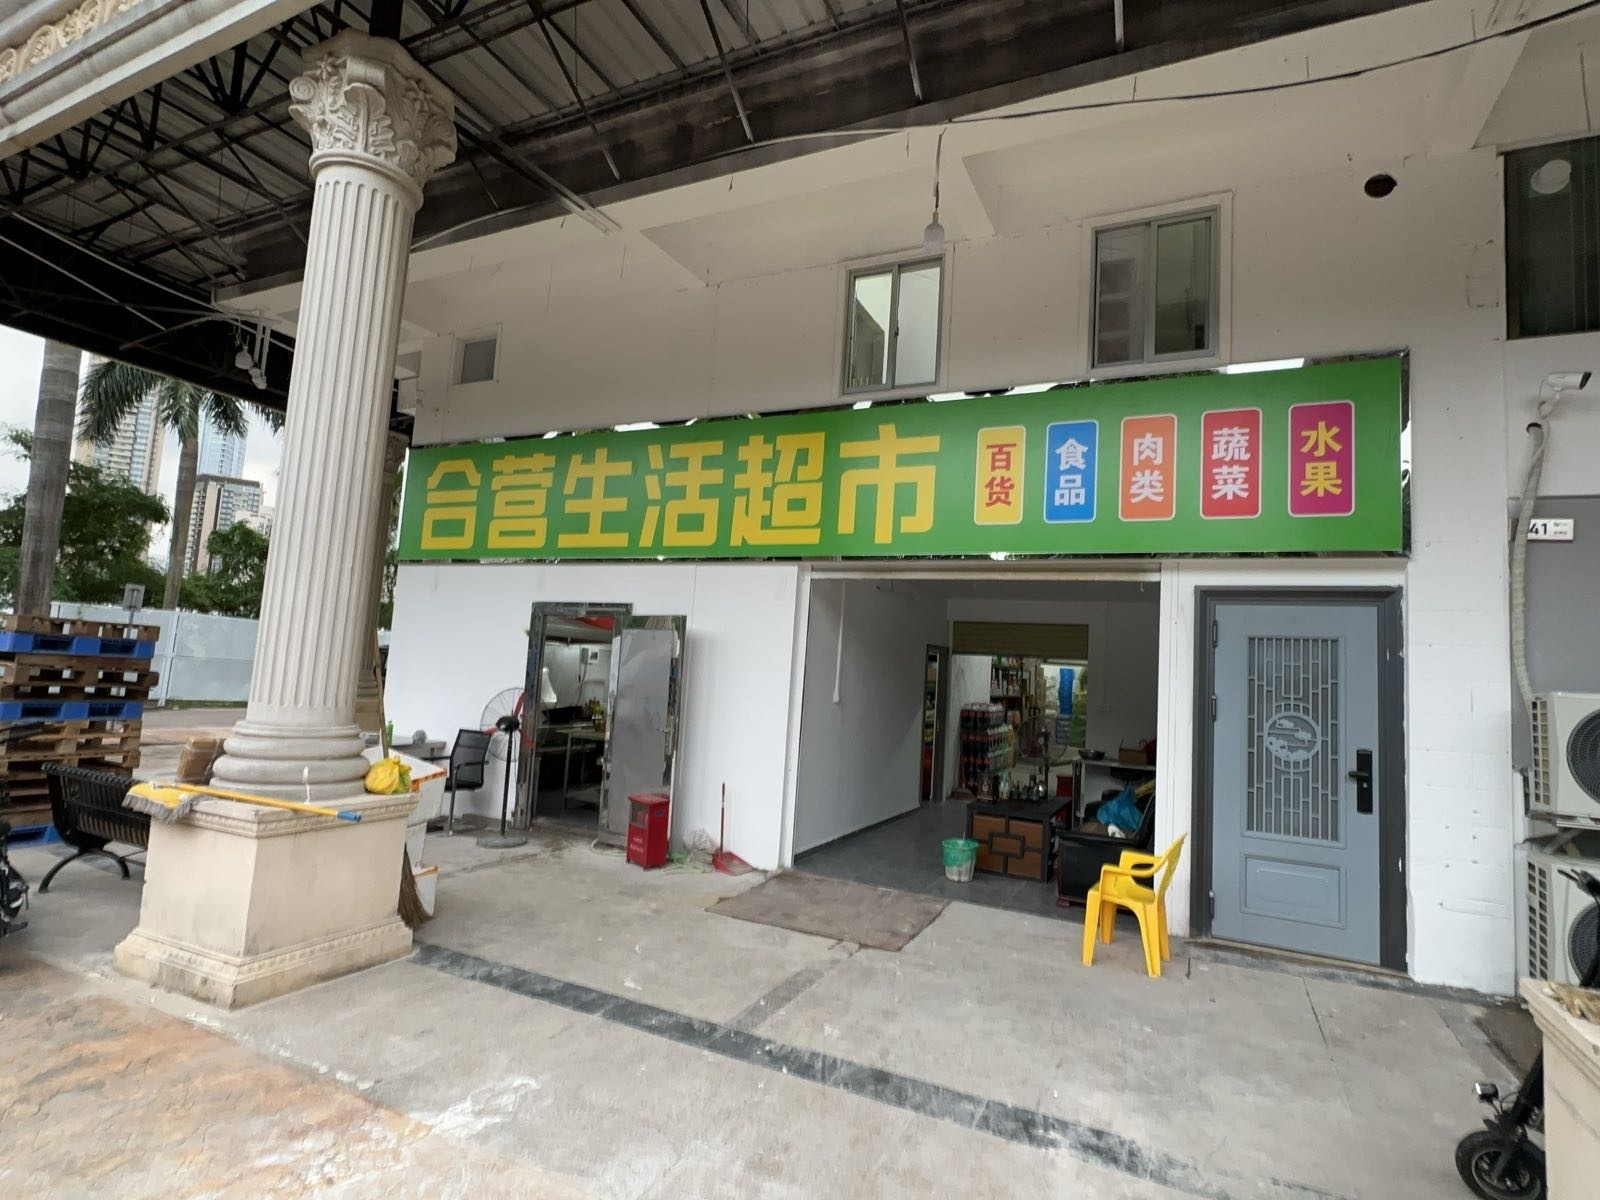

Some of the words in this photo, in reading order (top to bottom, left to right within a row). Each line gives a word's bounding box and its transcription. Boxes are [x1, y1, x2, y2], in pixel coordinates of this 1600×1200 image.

[421, 424, 941, 550] 合营生活超市
[984, 443, 1017, 507] 百货
[1055, 438, 1089, 506] 食品
[1130, 433, 1164, 504] 肉类
[1211, 426, 1250, 500] 蔬菜
[1300, 421, 1342, 497] 水果
